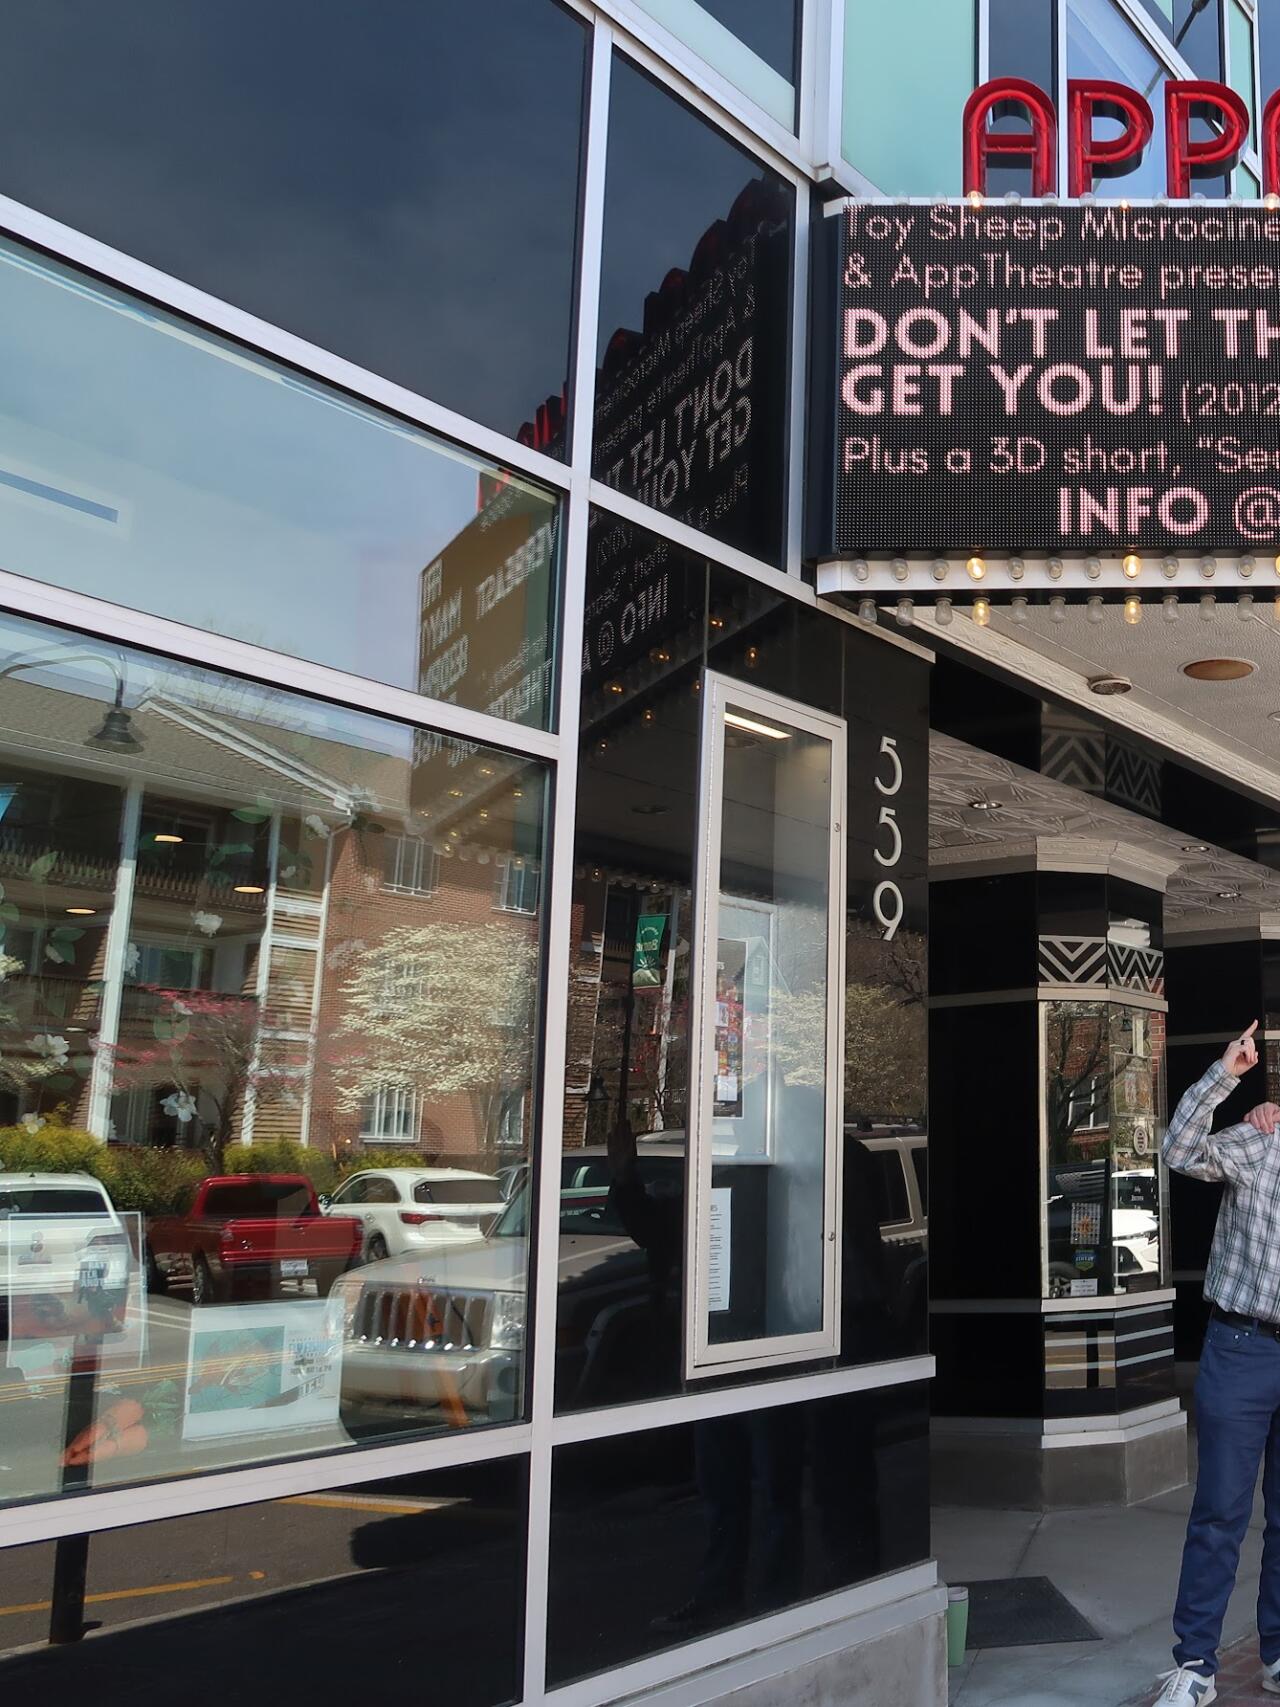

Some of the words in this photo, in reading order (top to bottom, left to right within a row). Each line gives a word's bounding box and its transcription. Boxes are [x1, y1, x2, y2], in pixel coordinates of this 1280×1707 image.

[843, 204, 915, 250] Toy
[930, 204, 1064, 250] Sheep
[845, 254, 871, 288] &
[891, 251, 1142, 298] AppTheatre
[844, 307, 1059, 358] DON'T
[1086, 309, 1190, 358] LET
[842, 364, 965, 415] GET
[988, 363, 1162, 415] YOU!
[845, 437, 928, 473] Plus
[947, 449, 970, 473] a
[991, 437, 1045, 473] 3D
[1063, 435, 1180, 477] short,
[1060, 487, 1208, 535] INFO
